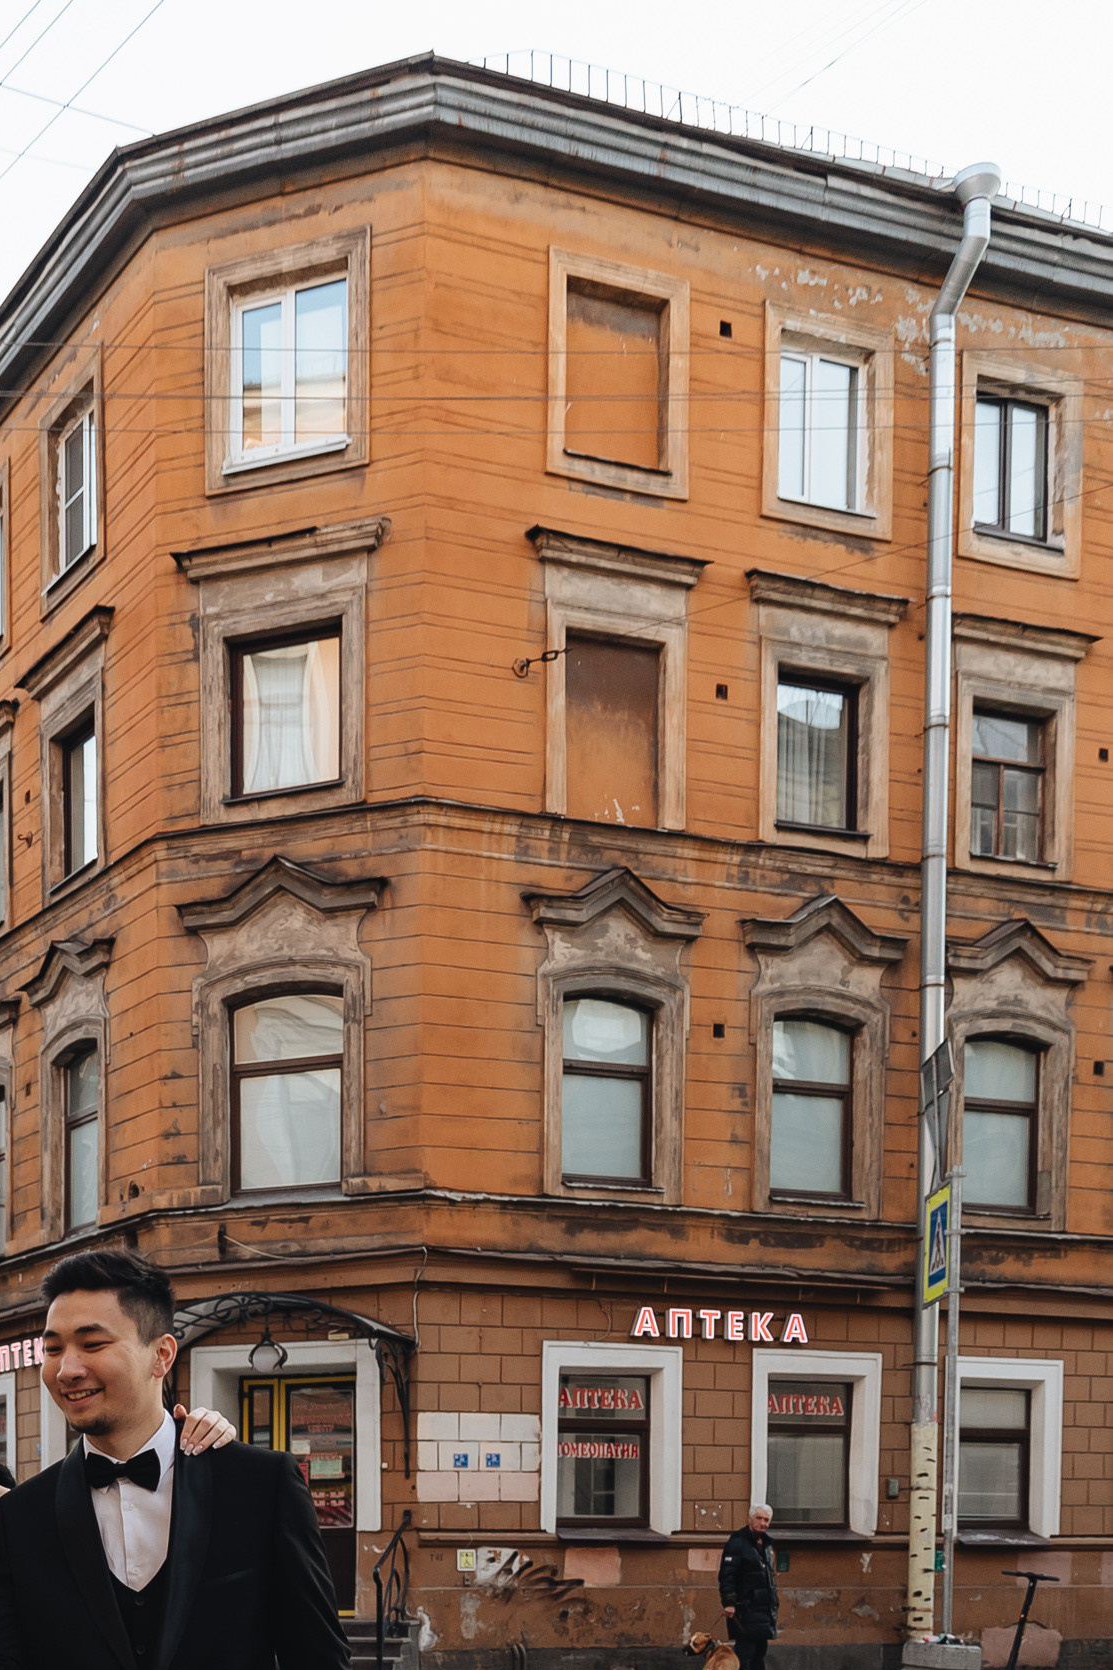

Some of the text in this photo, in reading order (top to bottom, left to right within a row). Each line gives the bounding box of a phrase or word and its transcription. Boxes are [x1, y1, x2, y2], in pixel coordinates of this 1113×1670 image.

[632, 1306, 808, 1343] АПТЕКА
[558, 1387, 644, 1410] АПТЕКА
[768, 1393, 844, 1416] АПТЕКА
[558, 1442, 639, 1459] ГОМЕОПАТИЯ
